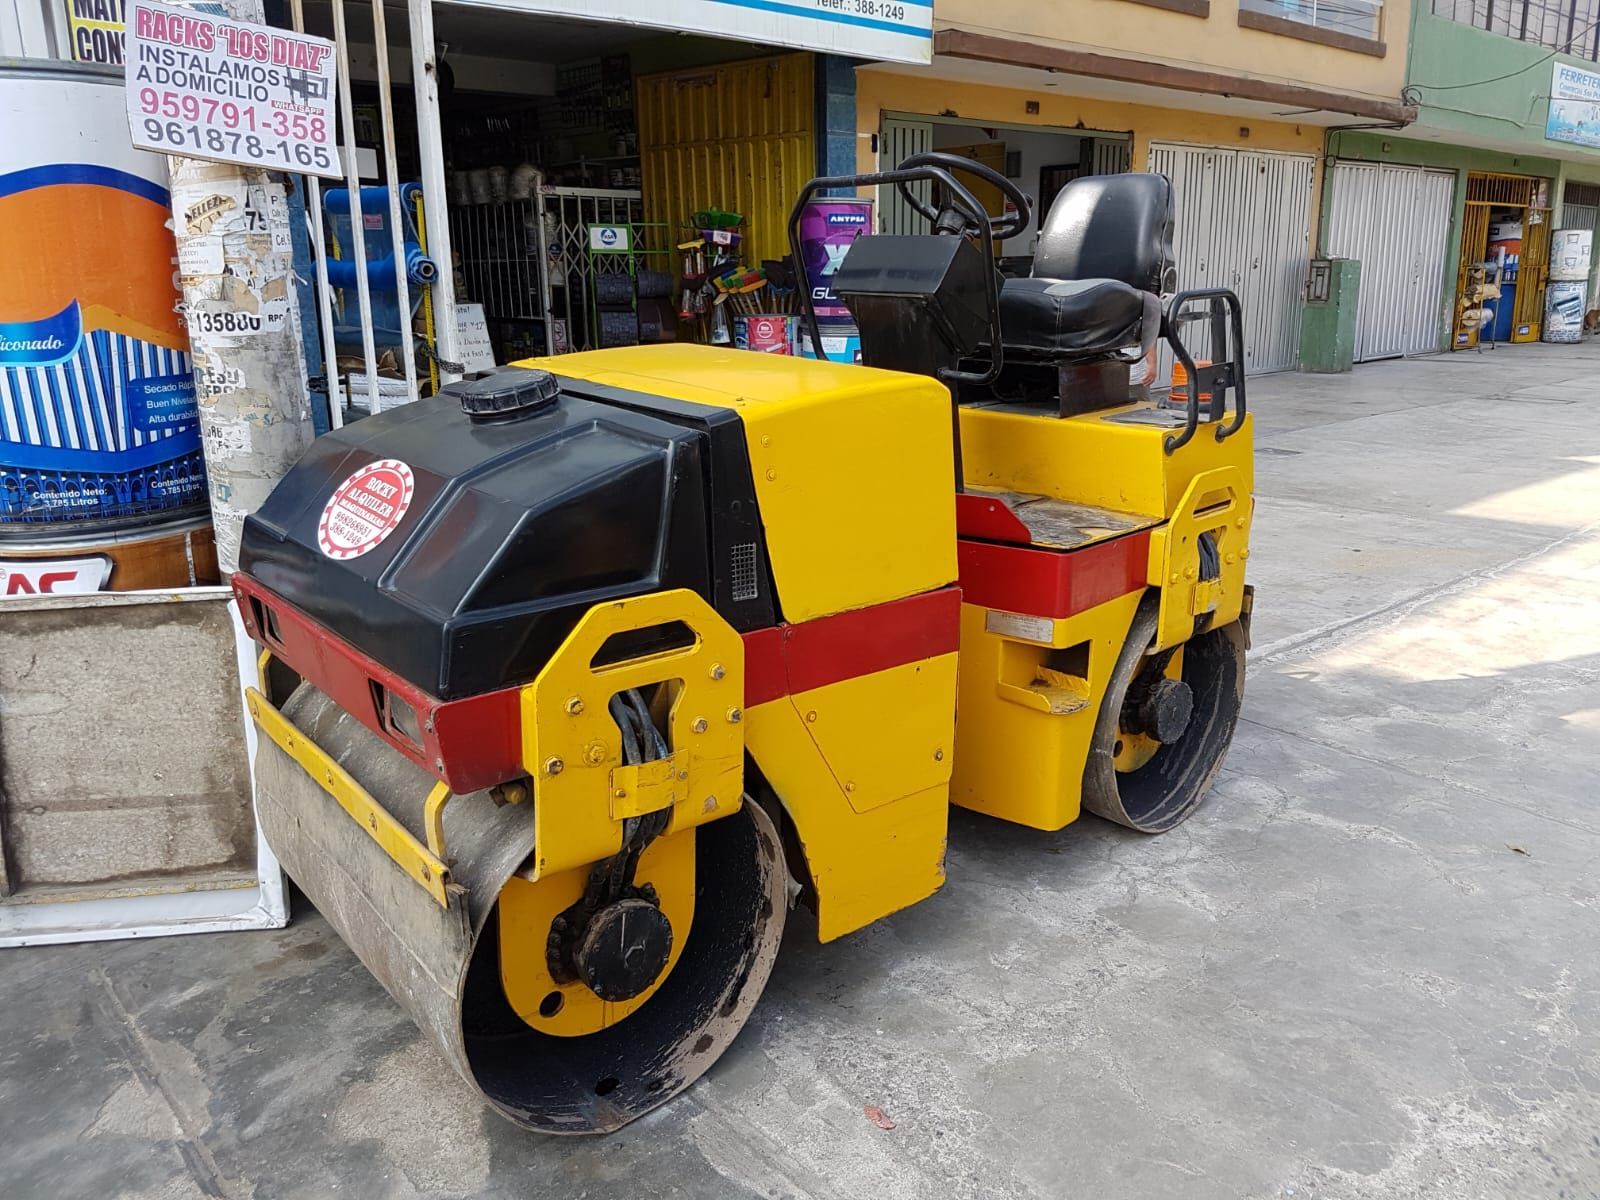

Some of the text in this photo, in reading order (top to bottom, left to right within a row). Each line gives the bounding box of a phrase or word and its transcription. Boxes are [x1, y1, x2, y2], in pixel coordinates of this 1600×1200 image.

[855, 0, 904, 20] 388-1249
[136, 6, 215, 52] RACKS
[139, 44, 280, 86] INSTALAMOS
[136, 65, 269, 102] A DOMICILIO
[140, 87, 326, 144] 959791-358
[273, 100, 323, 116] WHATSAPP
[144, 118, 330, 169] 961878-165
[144, 383, 177, 394] Secado
[146, 399, 170, 409] Buen
[148, 415, 167, 424] Alta
[152, 477, 189, 489] Contenido
[365, 476, 399, 500] ROCKY
[32, 488, 108, 500] Contenido Neto:
[71, 497, 99, 506] Litros
